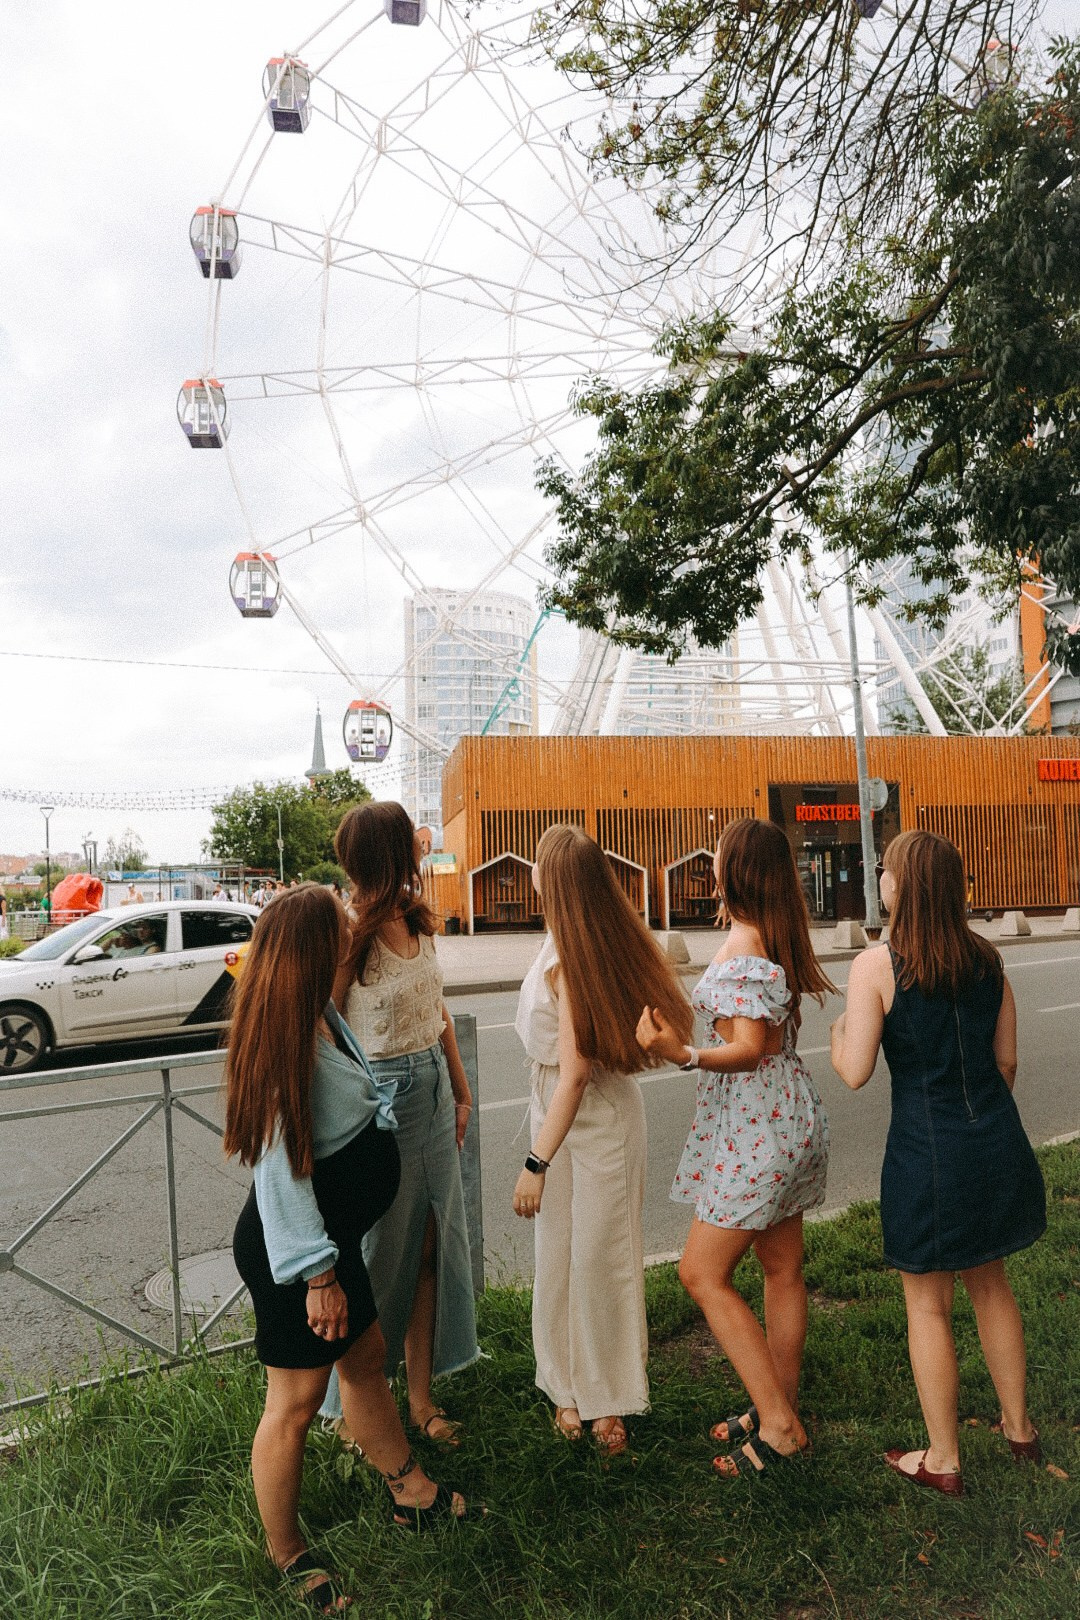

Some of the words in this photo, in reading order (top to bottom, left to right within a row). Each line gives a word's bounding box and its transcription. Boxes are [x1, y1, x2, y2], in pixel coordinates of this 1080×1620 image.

[796, 804, 875, 821] ROASTBER
[72, 974, 111, 985] Яндекс
[112, 967, 129, 981] Go
[73, 989, 104, 1000] Такси
